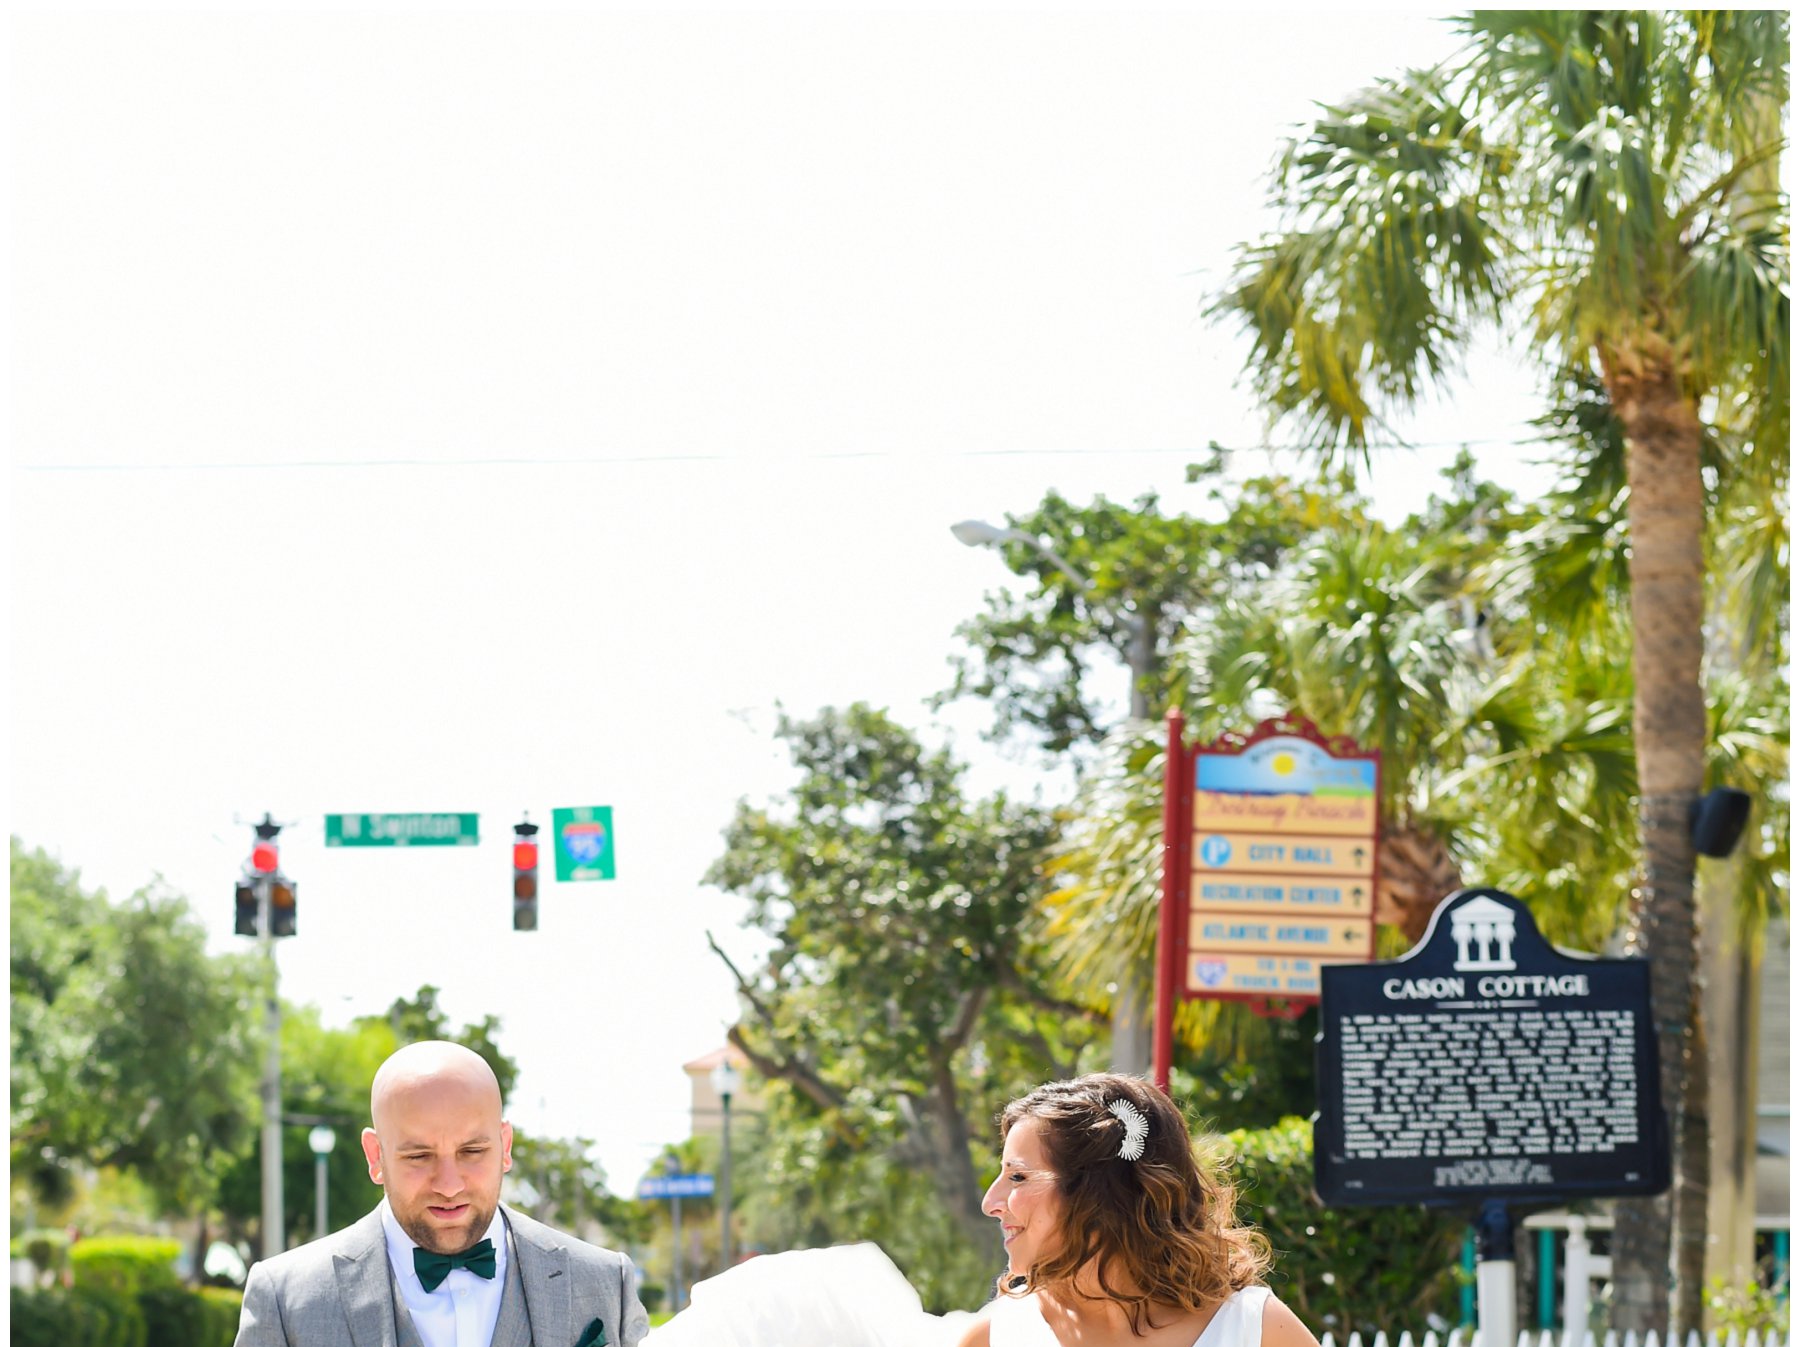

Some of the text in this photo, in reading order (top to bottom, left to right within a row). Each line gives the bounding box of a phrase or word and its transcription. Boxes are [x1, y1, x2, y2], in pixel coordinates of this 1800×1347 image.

[368, 814, 461, 839] Swinton
[1249, 844, 1332, 863] CITY HALL
[1202, 884, 1341, 903] RECREATION CENTER
[1203, 924, 1329, 942] ATLANTIC AVENUE
[1383, 975, 1590, 1000] CASON COTTAGE
